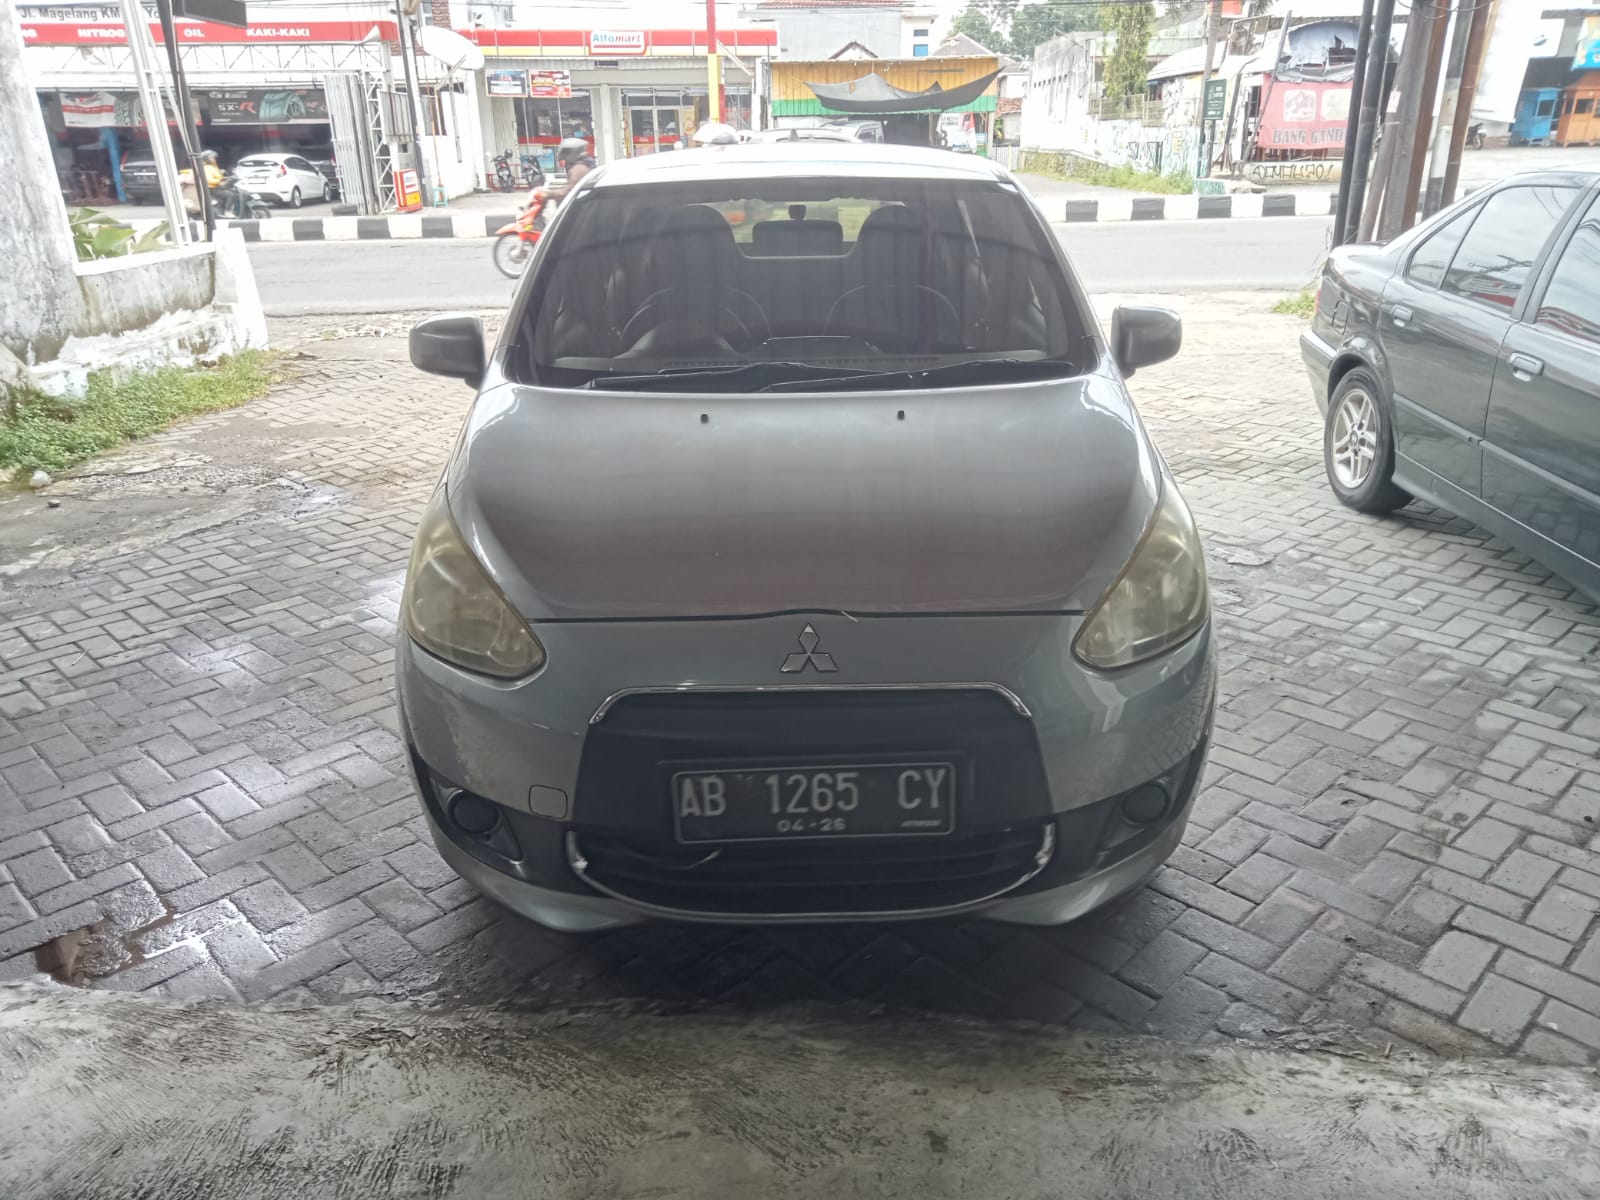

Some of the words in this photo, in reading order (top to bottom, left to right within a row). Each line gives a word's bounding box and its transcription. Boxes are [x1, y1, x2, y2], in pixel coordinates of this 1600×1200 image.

[21, 8, 35, 18] Jl.
[39, 8, 97, 21] Magelang
[184, 28, 205, 37] OIL
[246, 28, 310, 37] KAKI-KAKI
[593, 33, 641, 43] Alfamart
[1273, 129, 1307, 144] BANG
[1311, 127, 1344, 144] GAND
[680, 776, 726, 817] AB
[764, 772, 860, 815] 1265
[897, 768, 947, 810] CY
